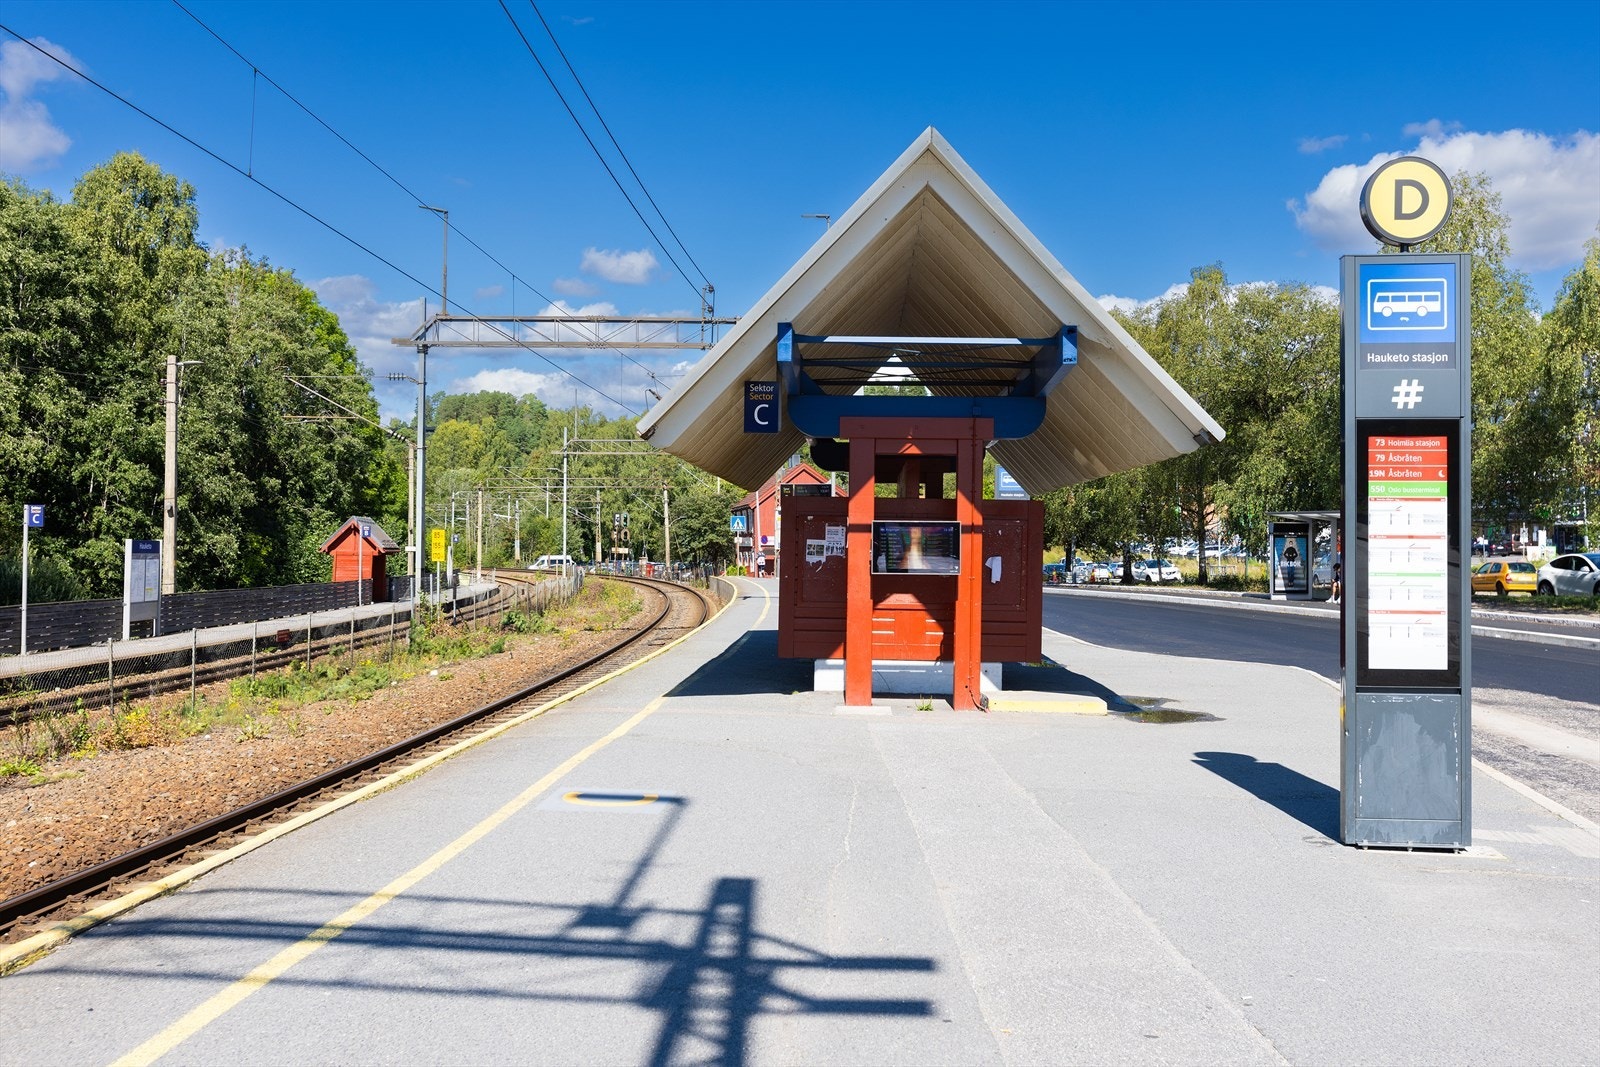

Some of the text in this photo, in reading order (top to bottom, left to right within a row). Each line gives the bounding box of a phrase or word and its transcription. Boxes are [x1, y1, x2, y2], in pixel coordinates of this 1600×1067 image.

[1394, 179, 1429, 220] D
[1367, 352, 1448, 364] Hauketo stasjon
[754, 404, 769, 425] C
[1375, 439, 1385, 447] 73
[1415, 440, 1441, 448] stasjon
[1375, 452, 1423, 462] 79 Åsbråten
[1369, 468, 1423, 478] 19N Åsbråten
[32, 514, 40, 523] C
